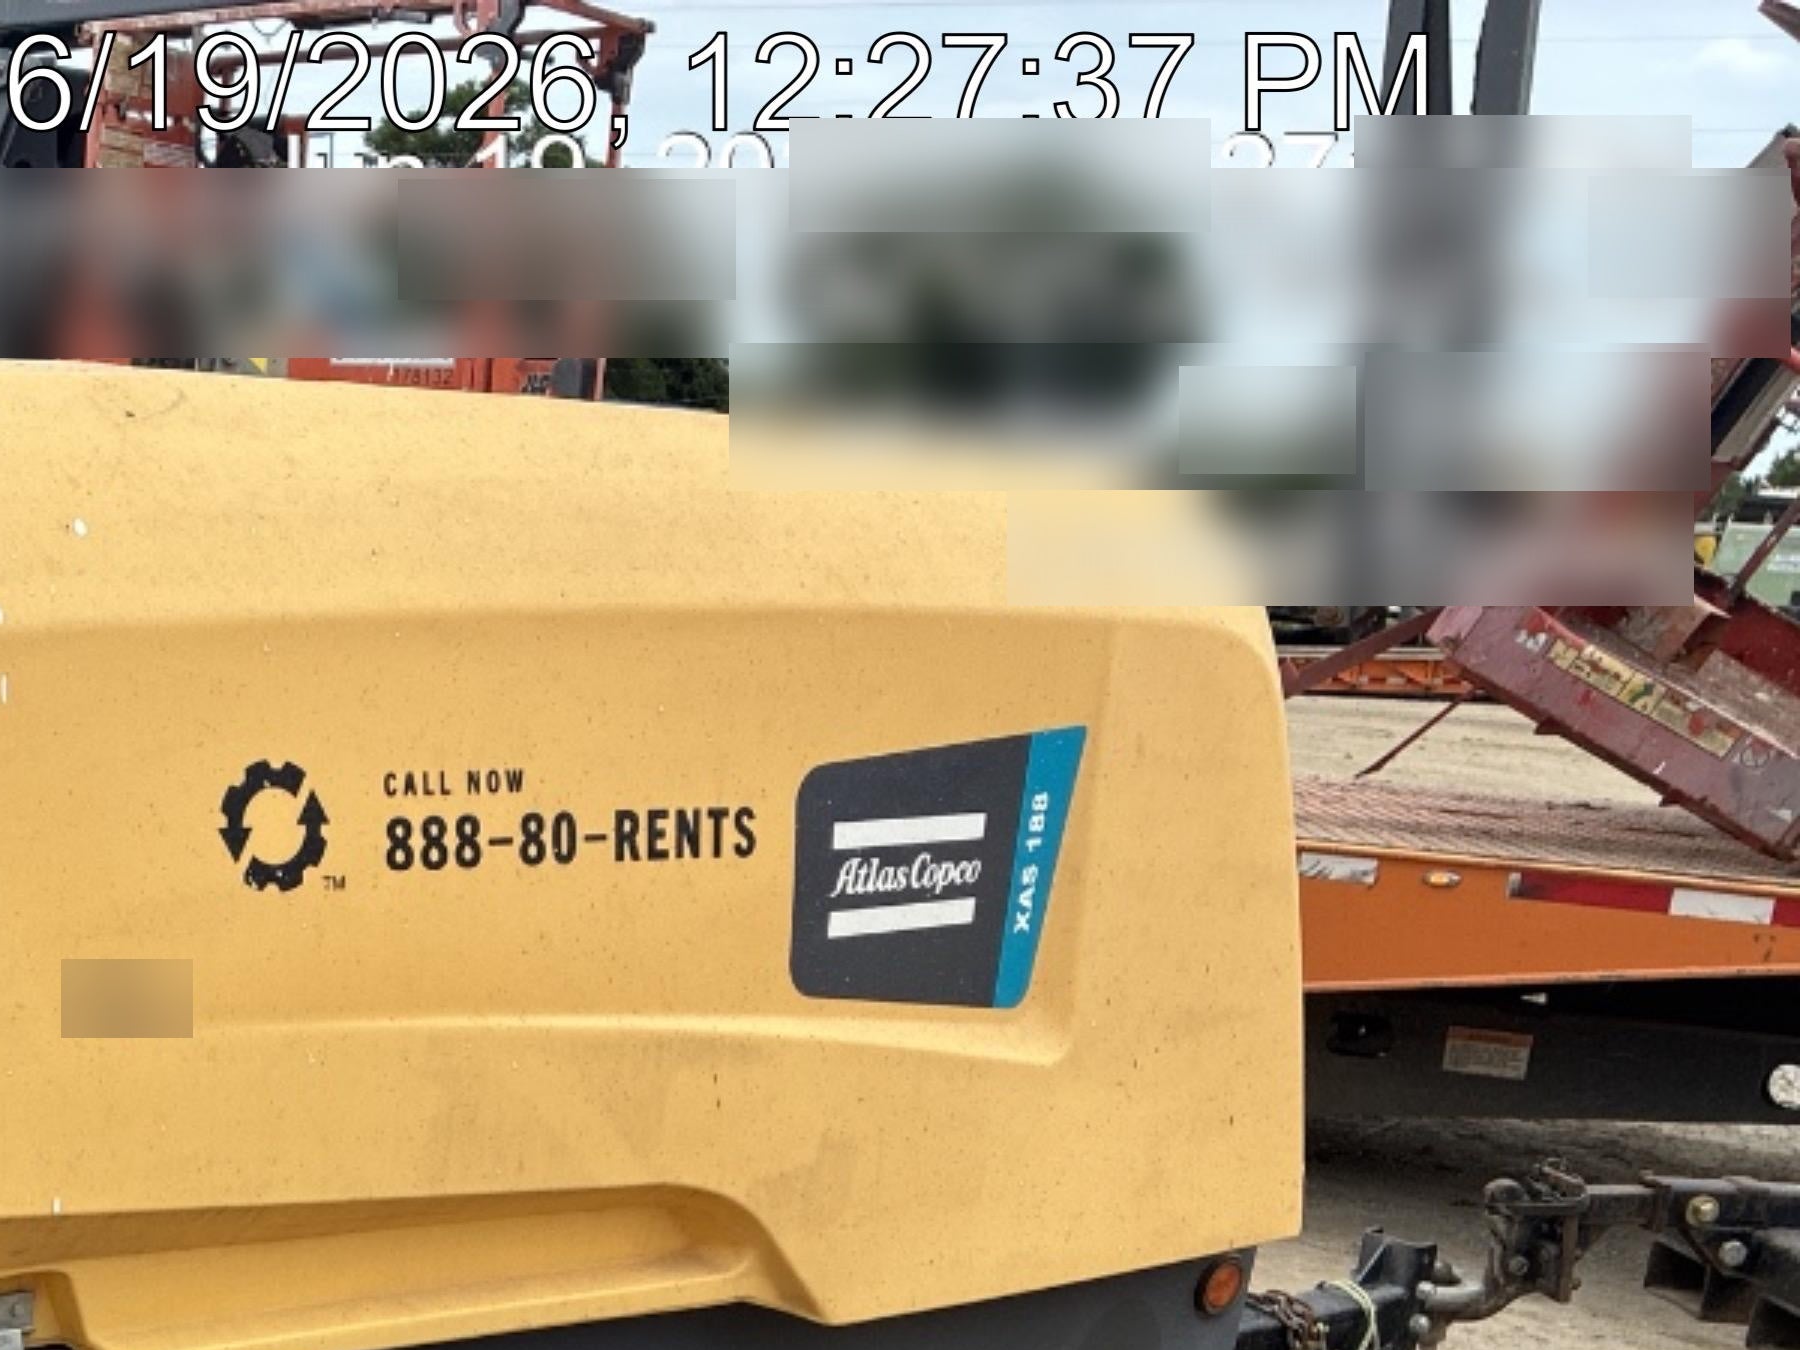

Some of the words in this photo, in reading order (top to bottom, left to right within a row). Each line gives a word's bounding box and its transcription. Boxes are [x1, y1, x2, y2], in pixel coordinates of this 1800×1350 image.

[383, 770, 452, 797] CALL
[467, 768, 525, 796] NOW
[385, 805, 758, 872] 888-80-RENTS
[1025, 790, 1049, 852] 188
[826, 855, 910, 899] Atlas
[909, 851, 983, 896] Copco
[1013, 863, 1039, 934] XAS
